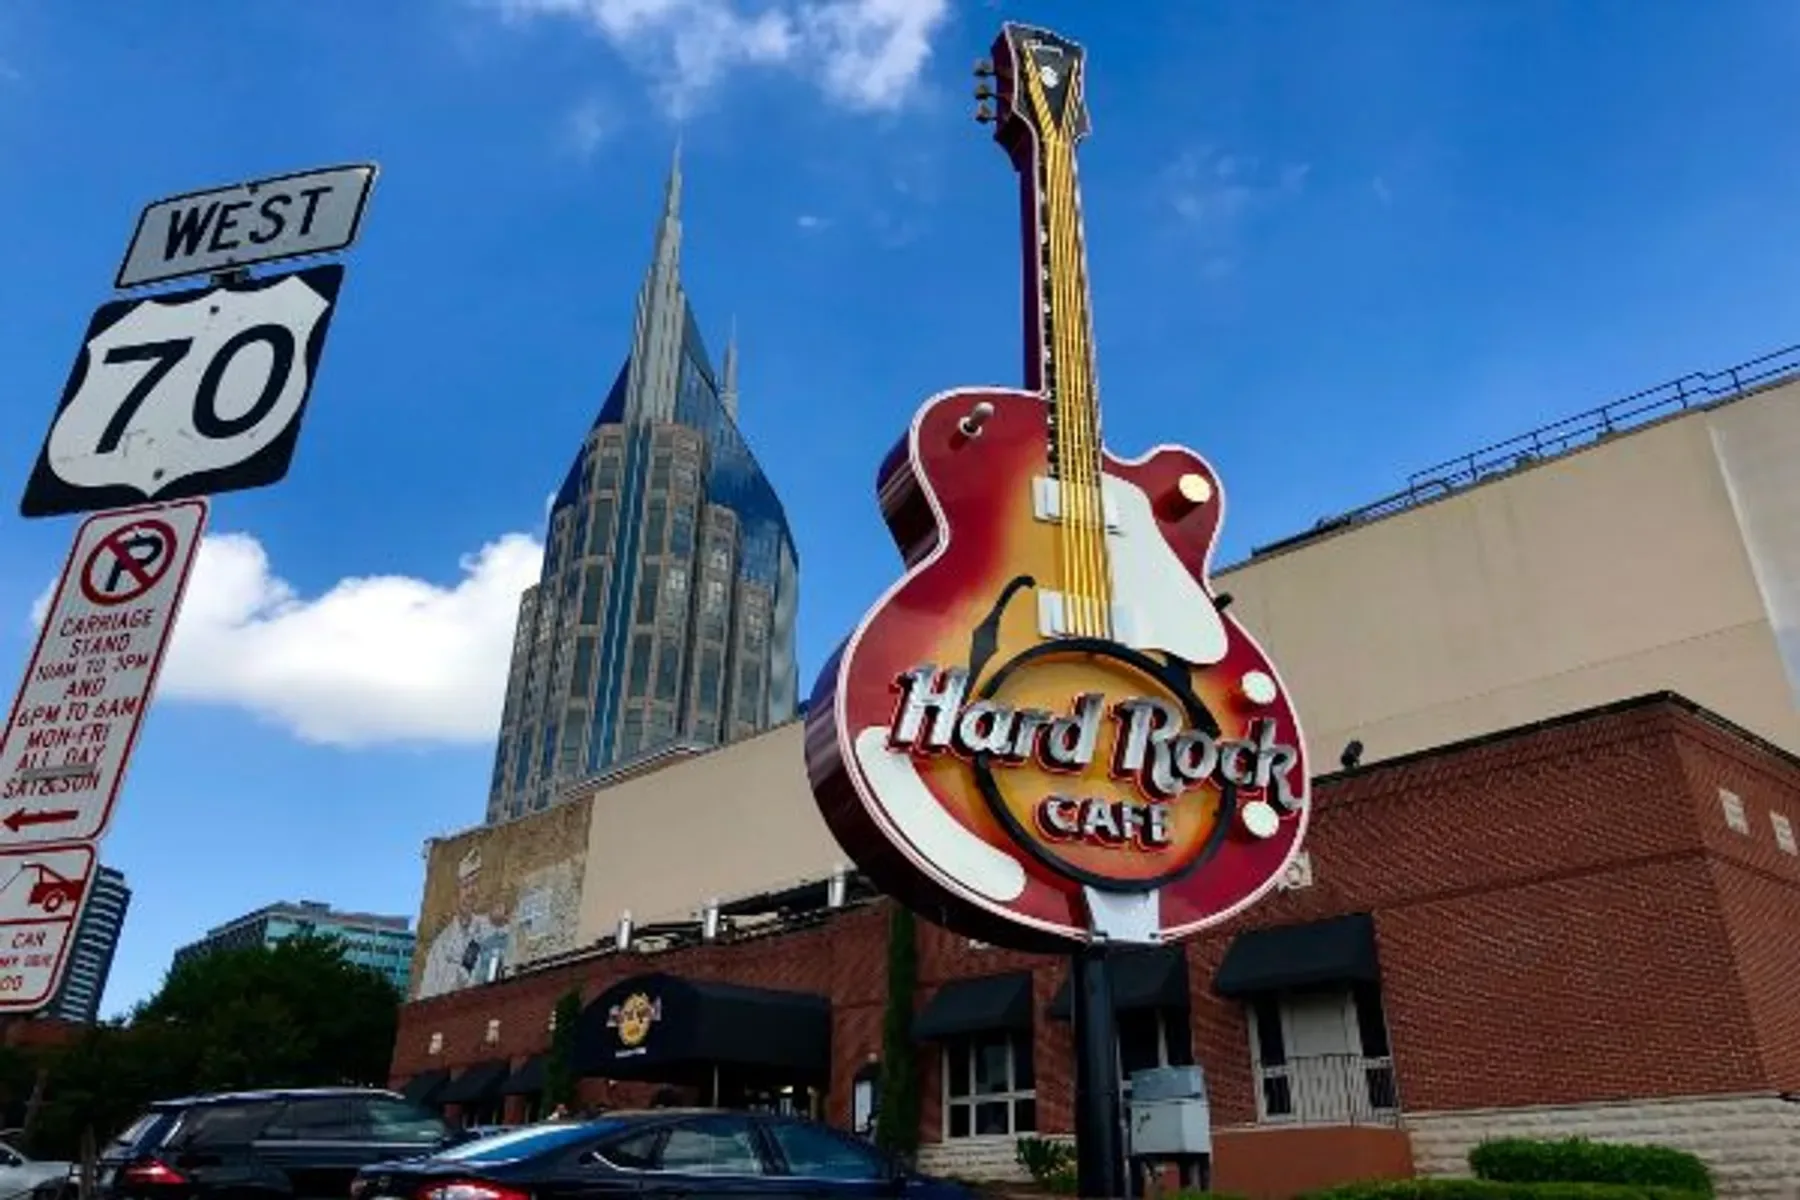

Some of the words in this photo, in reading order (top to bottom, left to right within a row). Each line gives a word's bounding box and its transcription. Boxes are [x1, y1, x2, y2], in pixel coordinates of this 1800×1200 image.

[164, 187, 332, 261] WEST
[95, 324, 295, 454] 70
[60, 608, 154, 637] CARRIAGE
[69, 633, 131, 658] STAND
[86, 657, 106, 675] TO
[62, 676, 106, 700] AND
[18, 704, 61, 727] 6PM
[65, 702, 88, 721] TO
[25, 722, 111, 750] MON-FRI
[889, 665, 1104, 773] Hard
[1110, 696, 1303, 818] Rock
[63, 743, 106, 768] DAY
[1037, 796, 1173, 853] CAFE
[11, 931, 47, 949] CAR
